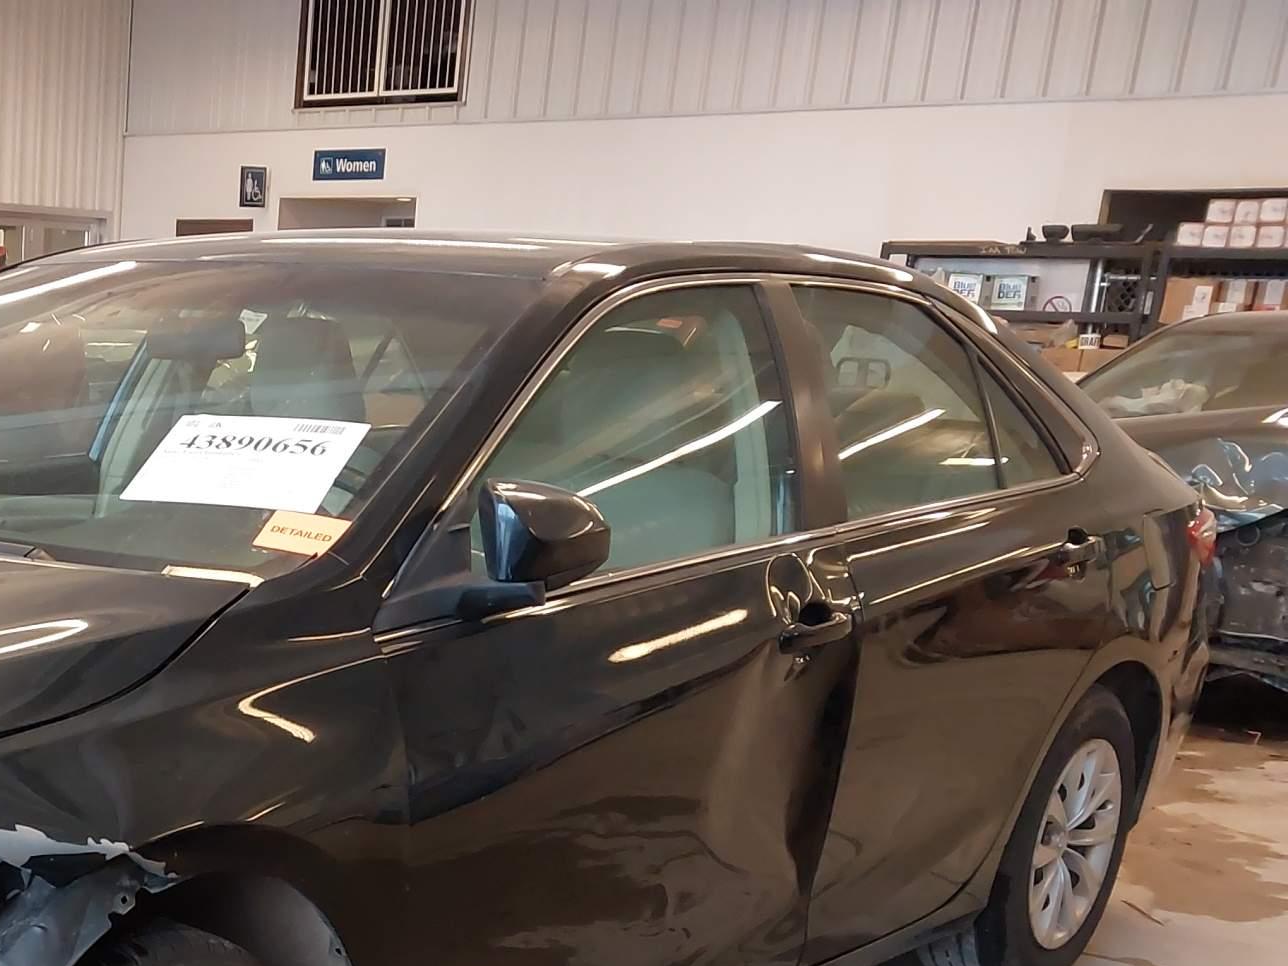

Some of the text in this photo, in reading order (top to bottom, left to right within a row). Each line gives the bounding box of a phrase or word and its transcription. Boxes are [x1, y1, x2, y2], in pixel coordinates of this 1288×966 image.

[335, 158, 376, 173] Women
[180, 434, 330, 457] 43890656
[270, 525, 332, 542] DETAILED
